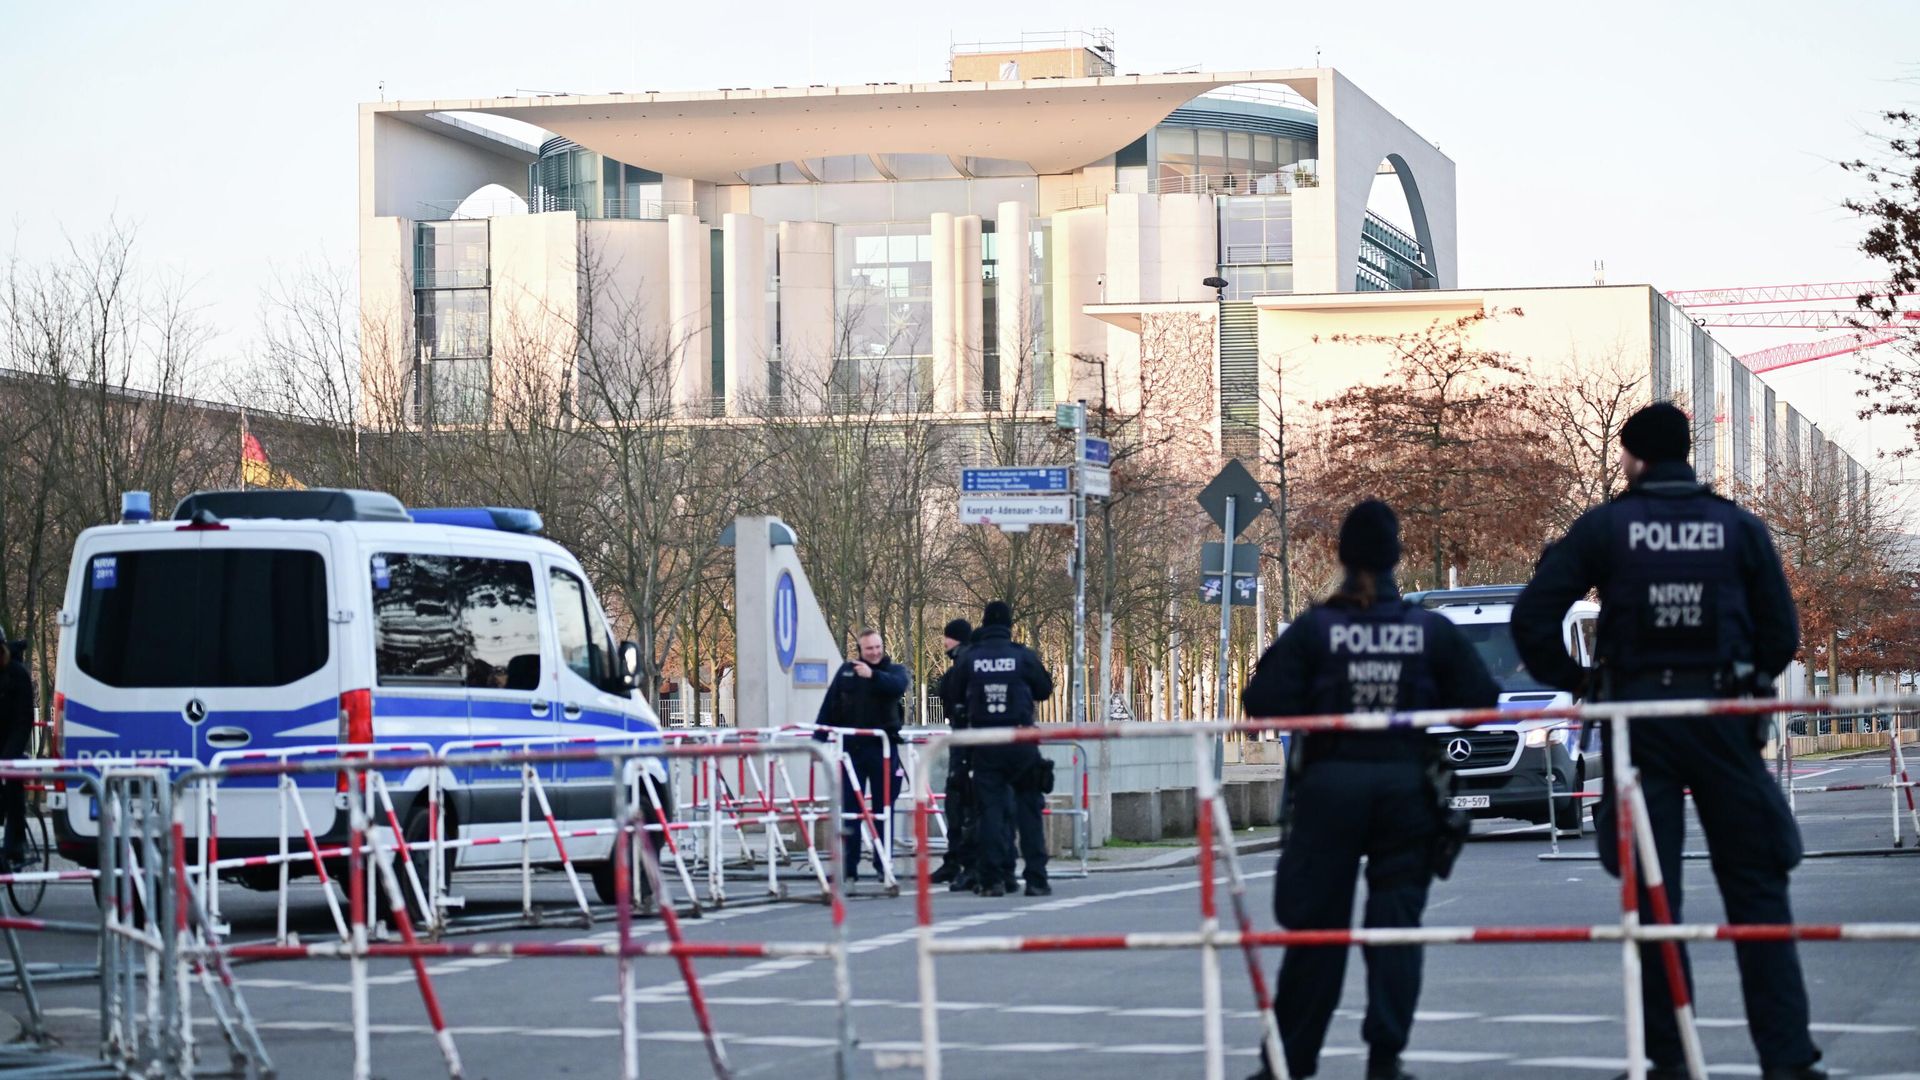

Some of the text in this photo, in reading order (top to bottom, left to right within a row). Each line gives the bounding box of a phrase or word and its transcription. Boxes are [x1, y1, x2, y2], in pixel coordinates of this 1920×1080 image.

[967, 506, 1063, 515] Konrad-Adenauer-Straße
[1629, 522, 1725, 551] POLIZEI
[94, 558, 116, 568] NRW
[1649, 583, 1703, 605] NRW
[779, 589, 792, 652] U
[1655, 606, 1702, 627] 2912
[1330, 624, 1424, 653] POLIZEI
[974, 658, 1016, 672] POLIZEI
[1348, 661, 1402, 682] NRW
[984, 684, 1008, 693] NRW
[1352, 683, 1398, 704] 2912
[1457, 797, 1488, 807] 29-597
